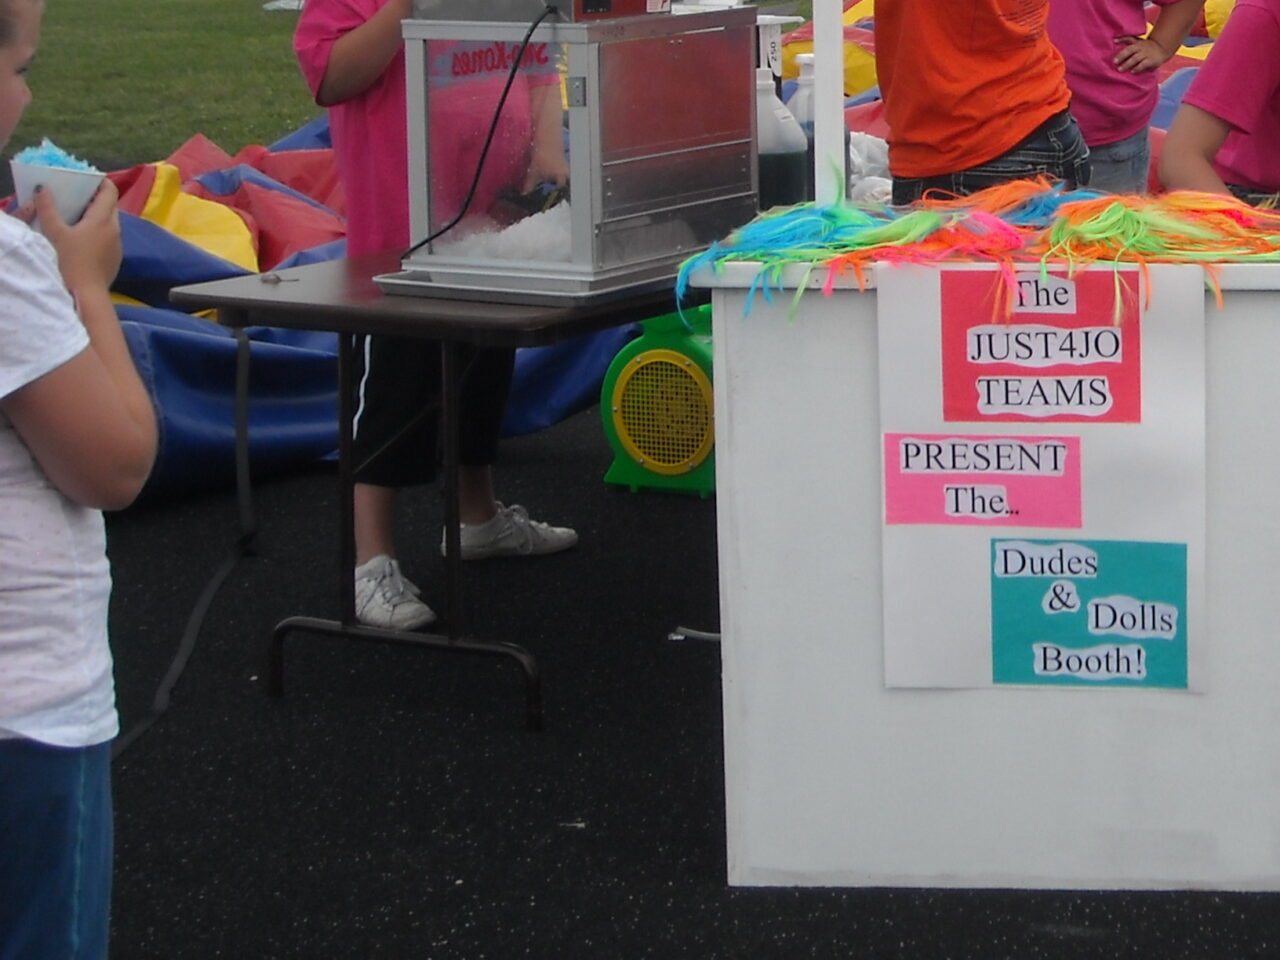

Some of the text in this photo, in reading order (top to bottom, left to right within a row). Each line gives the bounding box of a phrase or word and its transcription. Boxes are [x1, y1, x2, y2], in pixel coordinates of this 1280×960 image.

[1017, 280, 1070, 307] The
[970, 330, 1121, 361] JUST4JO
[978, 378, 1108, 407] TEAMS
[902, 442, 1067, 471] PRESENT
[1002, 548, 1098, 575] Dudes
[1048, 583, 1076, 611] &
[1093, 603, 1173, 632] Dolls
[1040, 645, 1142, 674] Booth!
